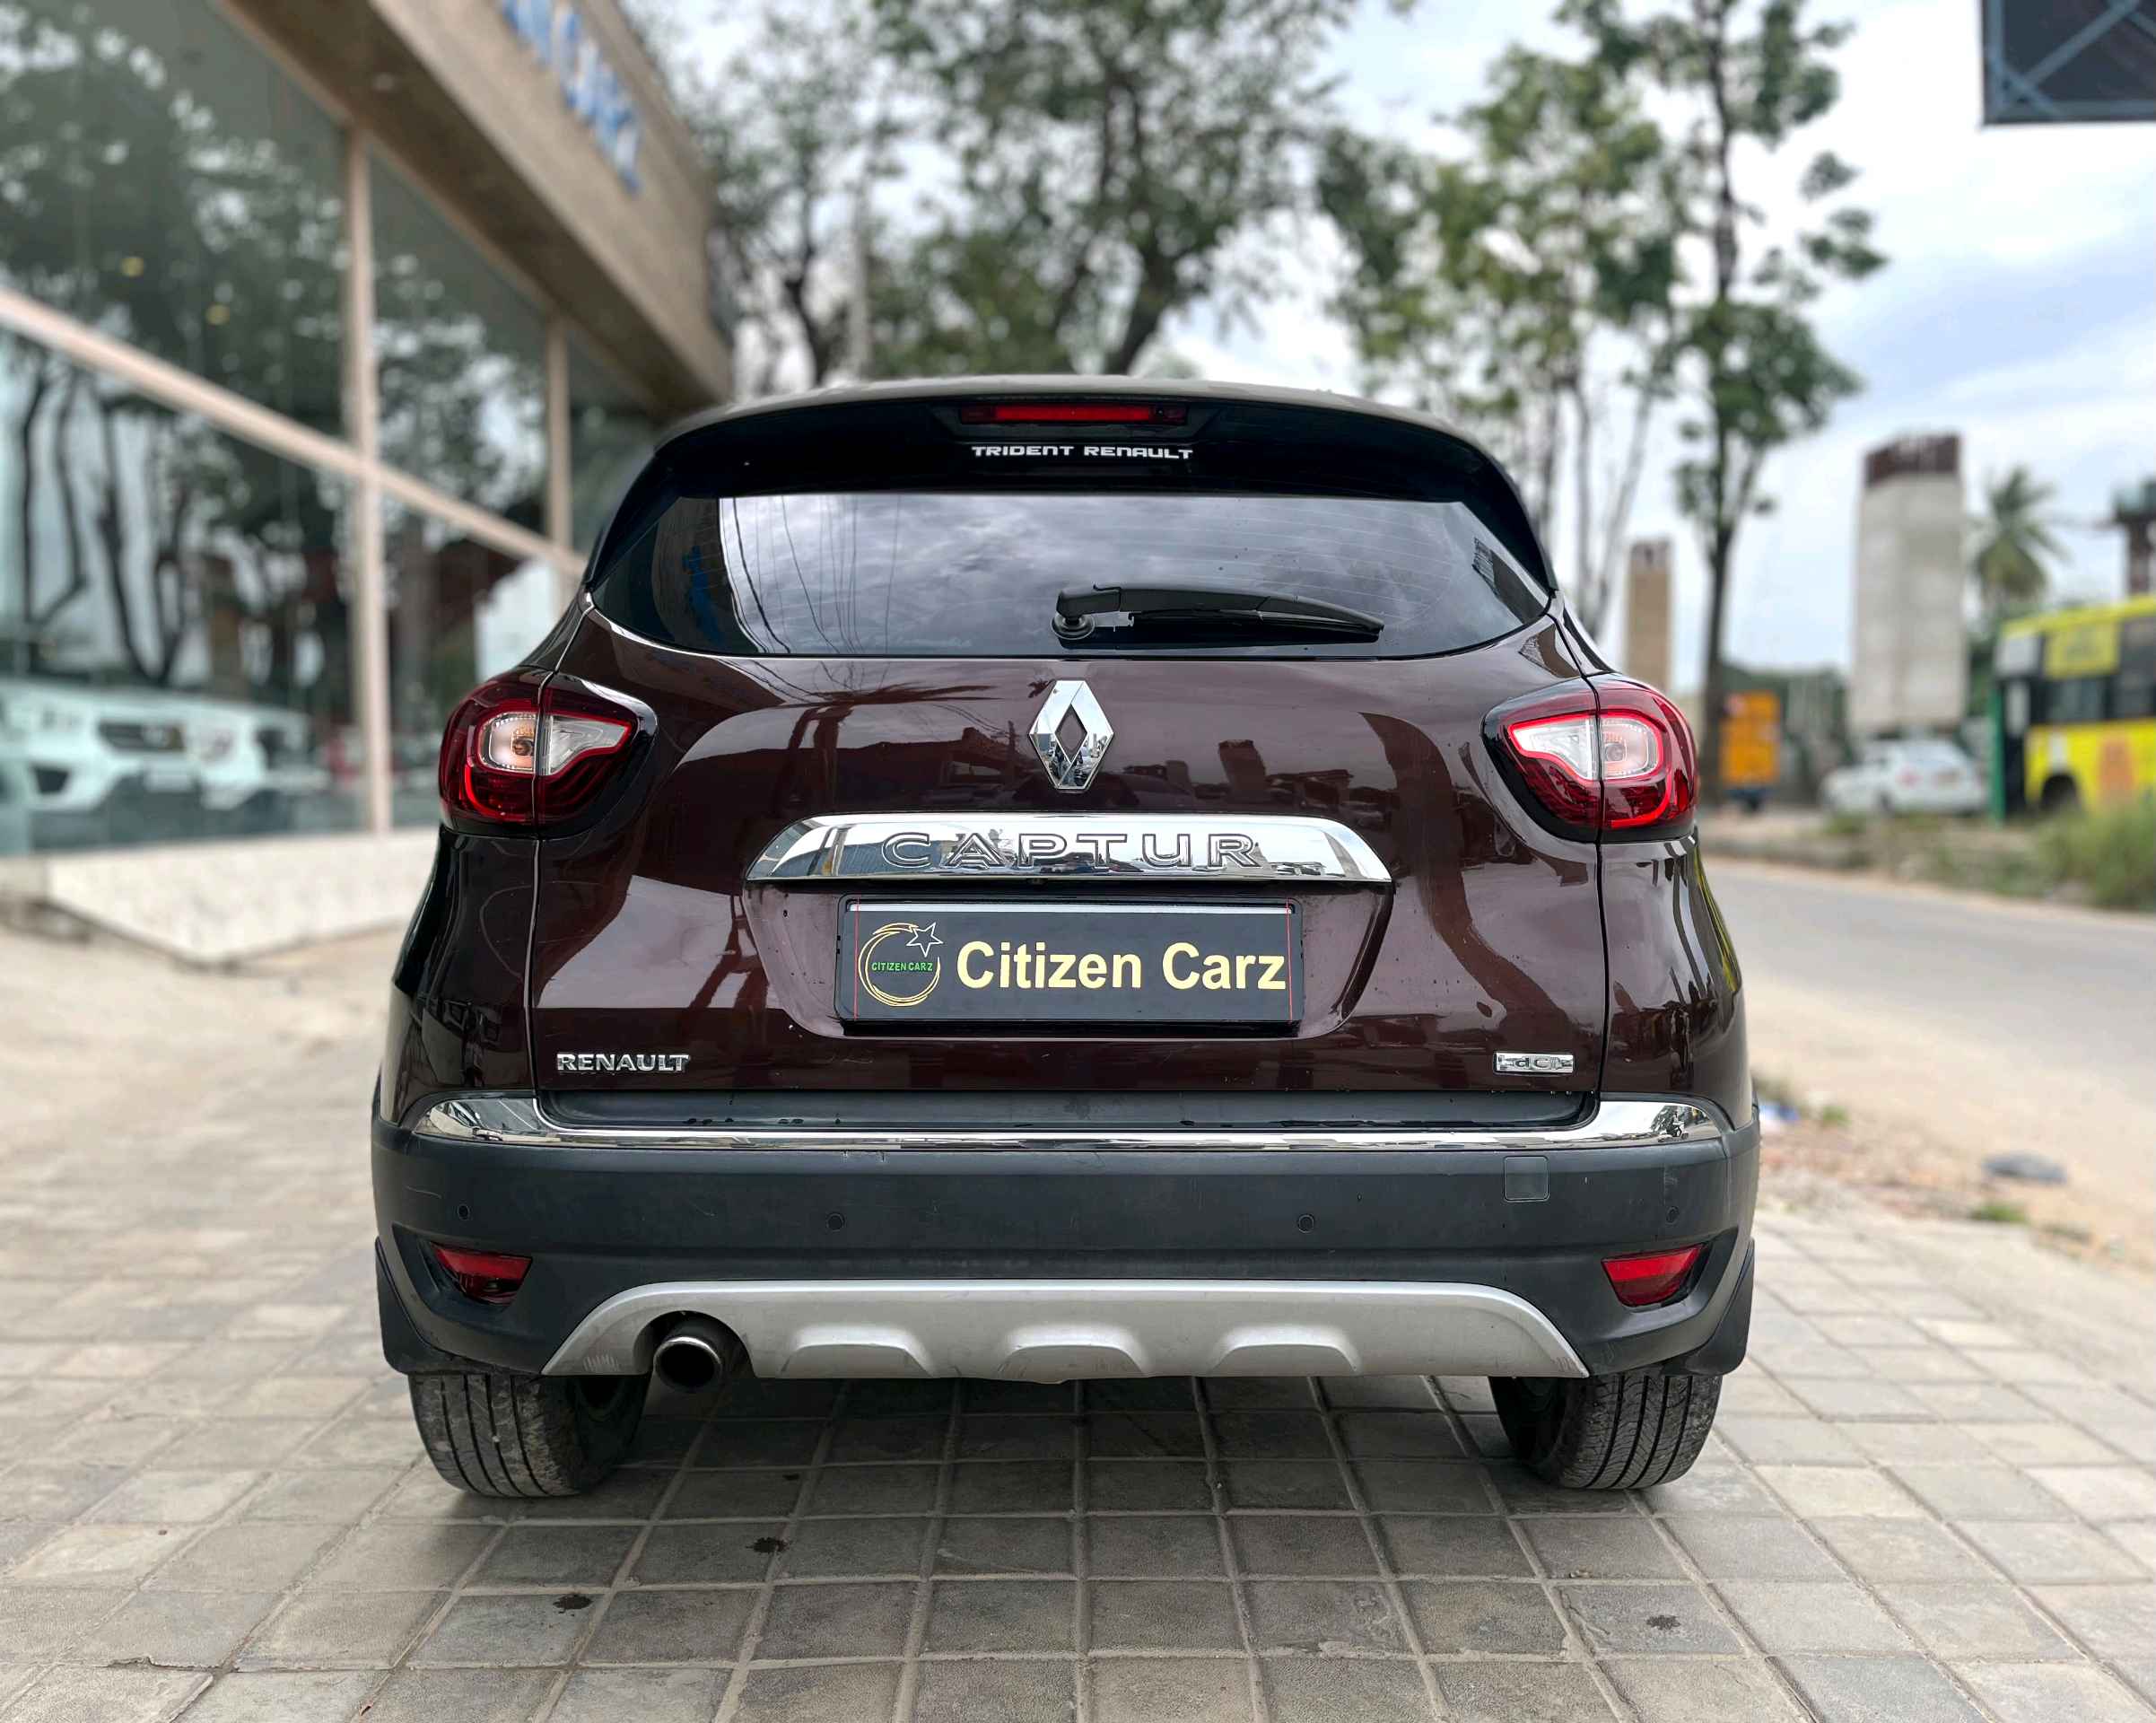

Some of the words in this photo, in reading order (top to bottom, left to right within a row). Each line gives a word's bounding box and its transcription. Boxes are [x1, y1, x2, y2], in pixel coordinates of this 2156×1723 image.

[972, 445, 1074, 456] TRIDENT
[1084, 445, 1193, 459] RENAULT
[882, 832, 1261, 869] CAPTUR
[871, 962, 906, 971] CITIZEN
[908, 962, 933, 971] CARZ
[956, 940, 1142, 989] Citizen
[1162, 941, 1286, 990] Carz
[556, 1053, 691, 1071] RENAULT
